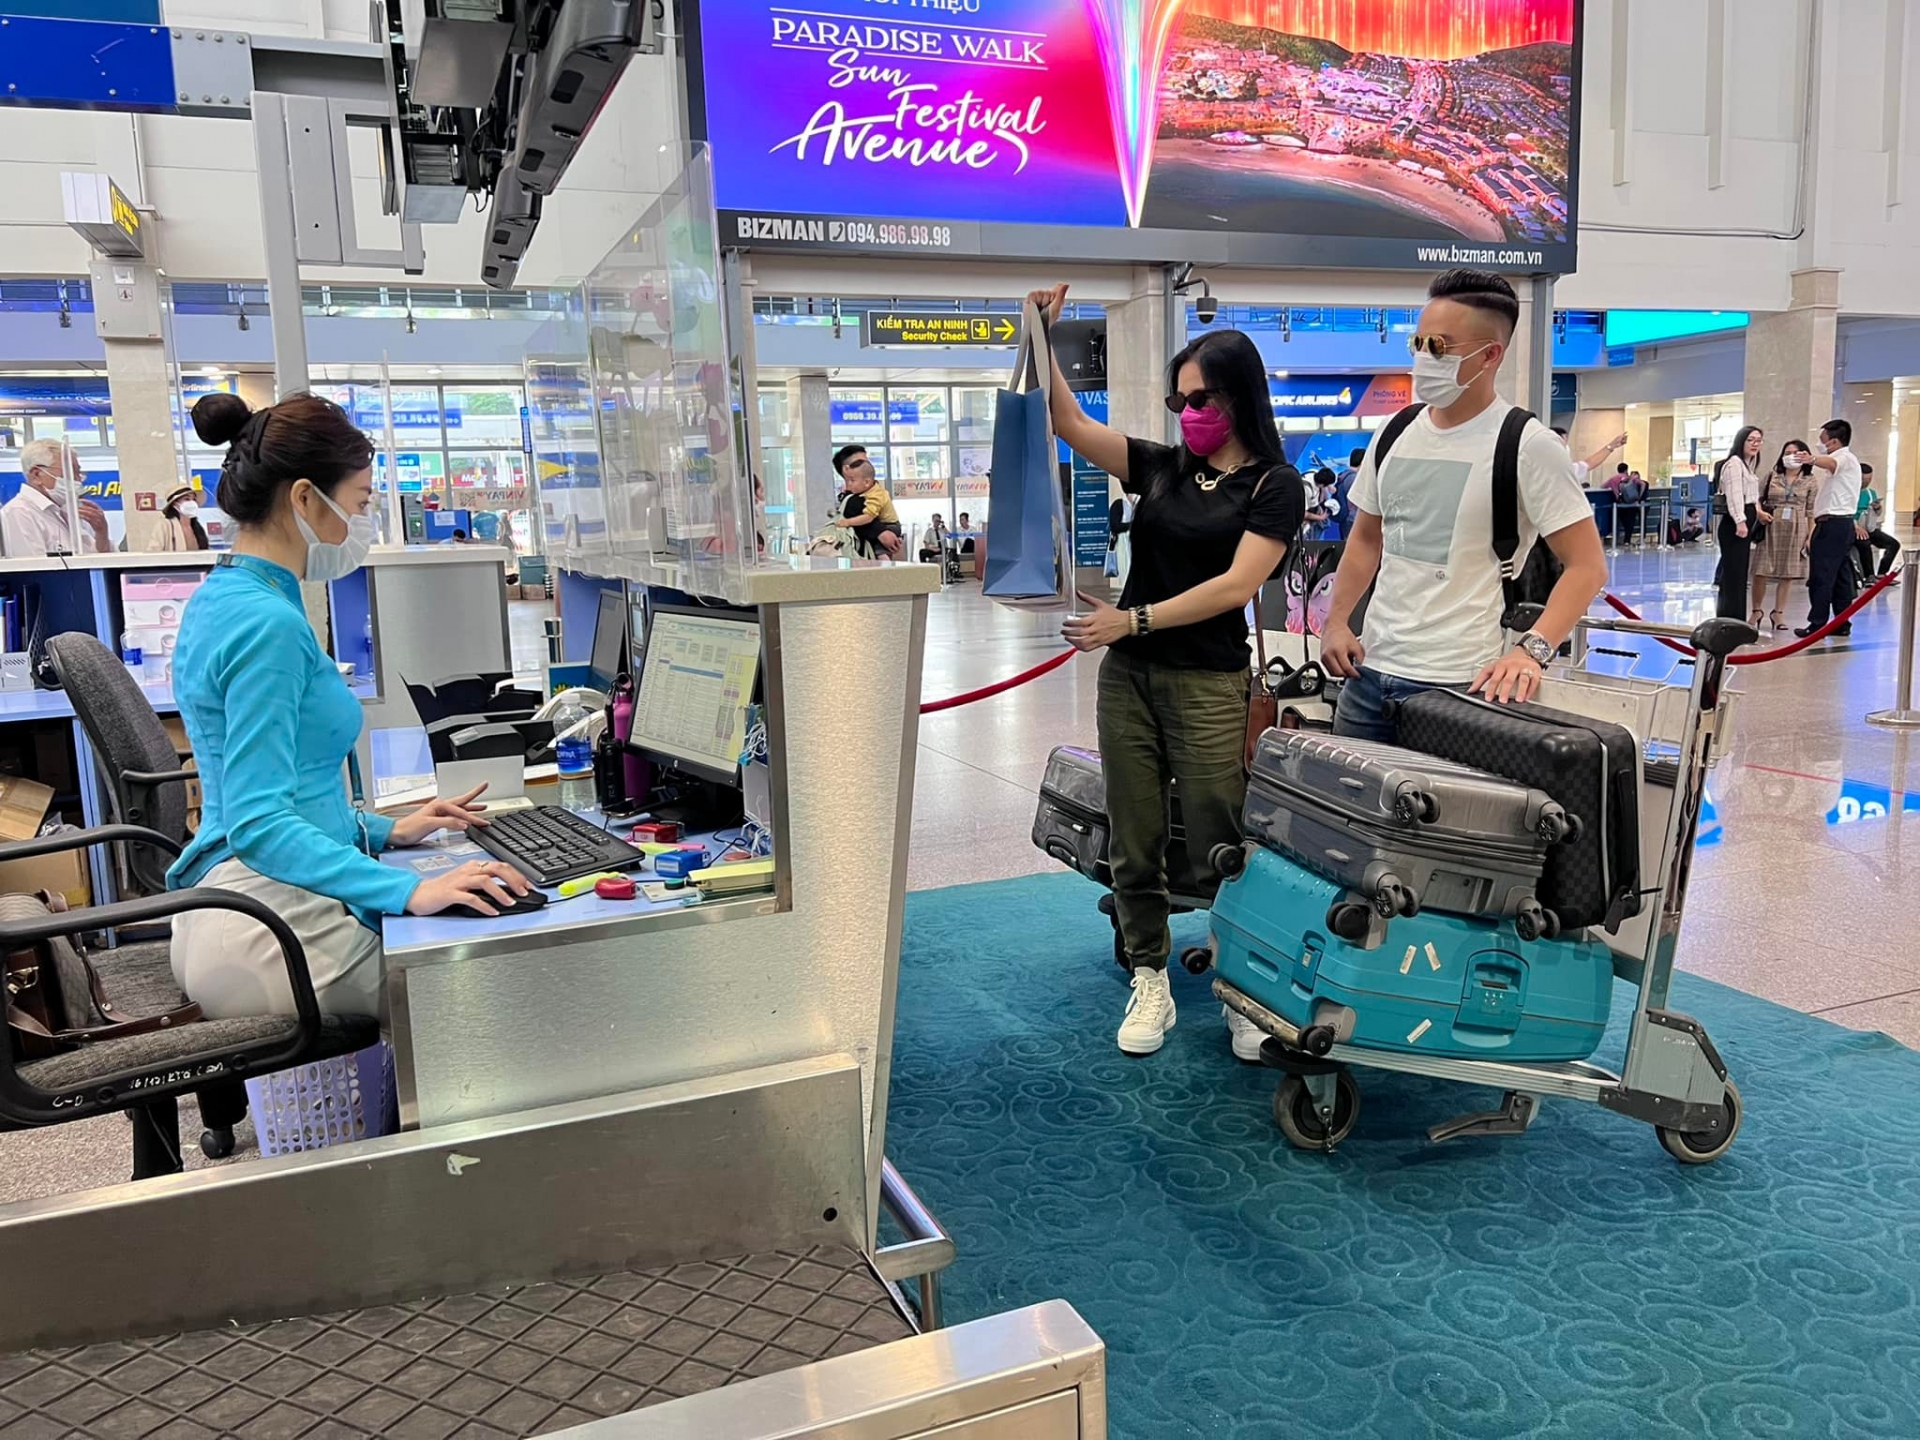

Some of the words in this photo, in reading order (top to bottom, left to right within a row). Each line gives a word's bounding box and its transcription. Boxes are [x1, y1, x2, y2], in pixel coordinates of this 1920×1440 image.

[772, 17, 942, 54] PARADISE
[951, 34, 1045, 64] WALK
[828, 48, 911, 88] Sun
[887, 84, 1047, 136] Festival
[768, 101, 1028, 176] Avenue
[737, 216, 824, 242] BIZMAN
[847, 222, 951, 246] 094.986.98.98
[1417, 244, 1542, 265] www.bizman.com.vn
[876, 315, 902, 329] KIỂM
[904, 319, 925, 329] TRA
[927, 319, 942, 329] AN
[943, 319, 968, 330] NINH
[902, 331, 938, 343] Security
[940, 331, 968, 341] Check
